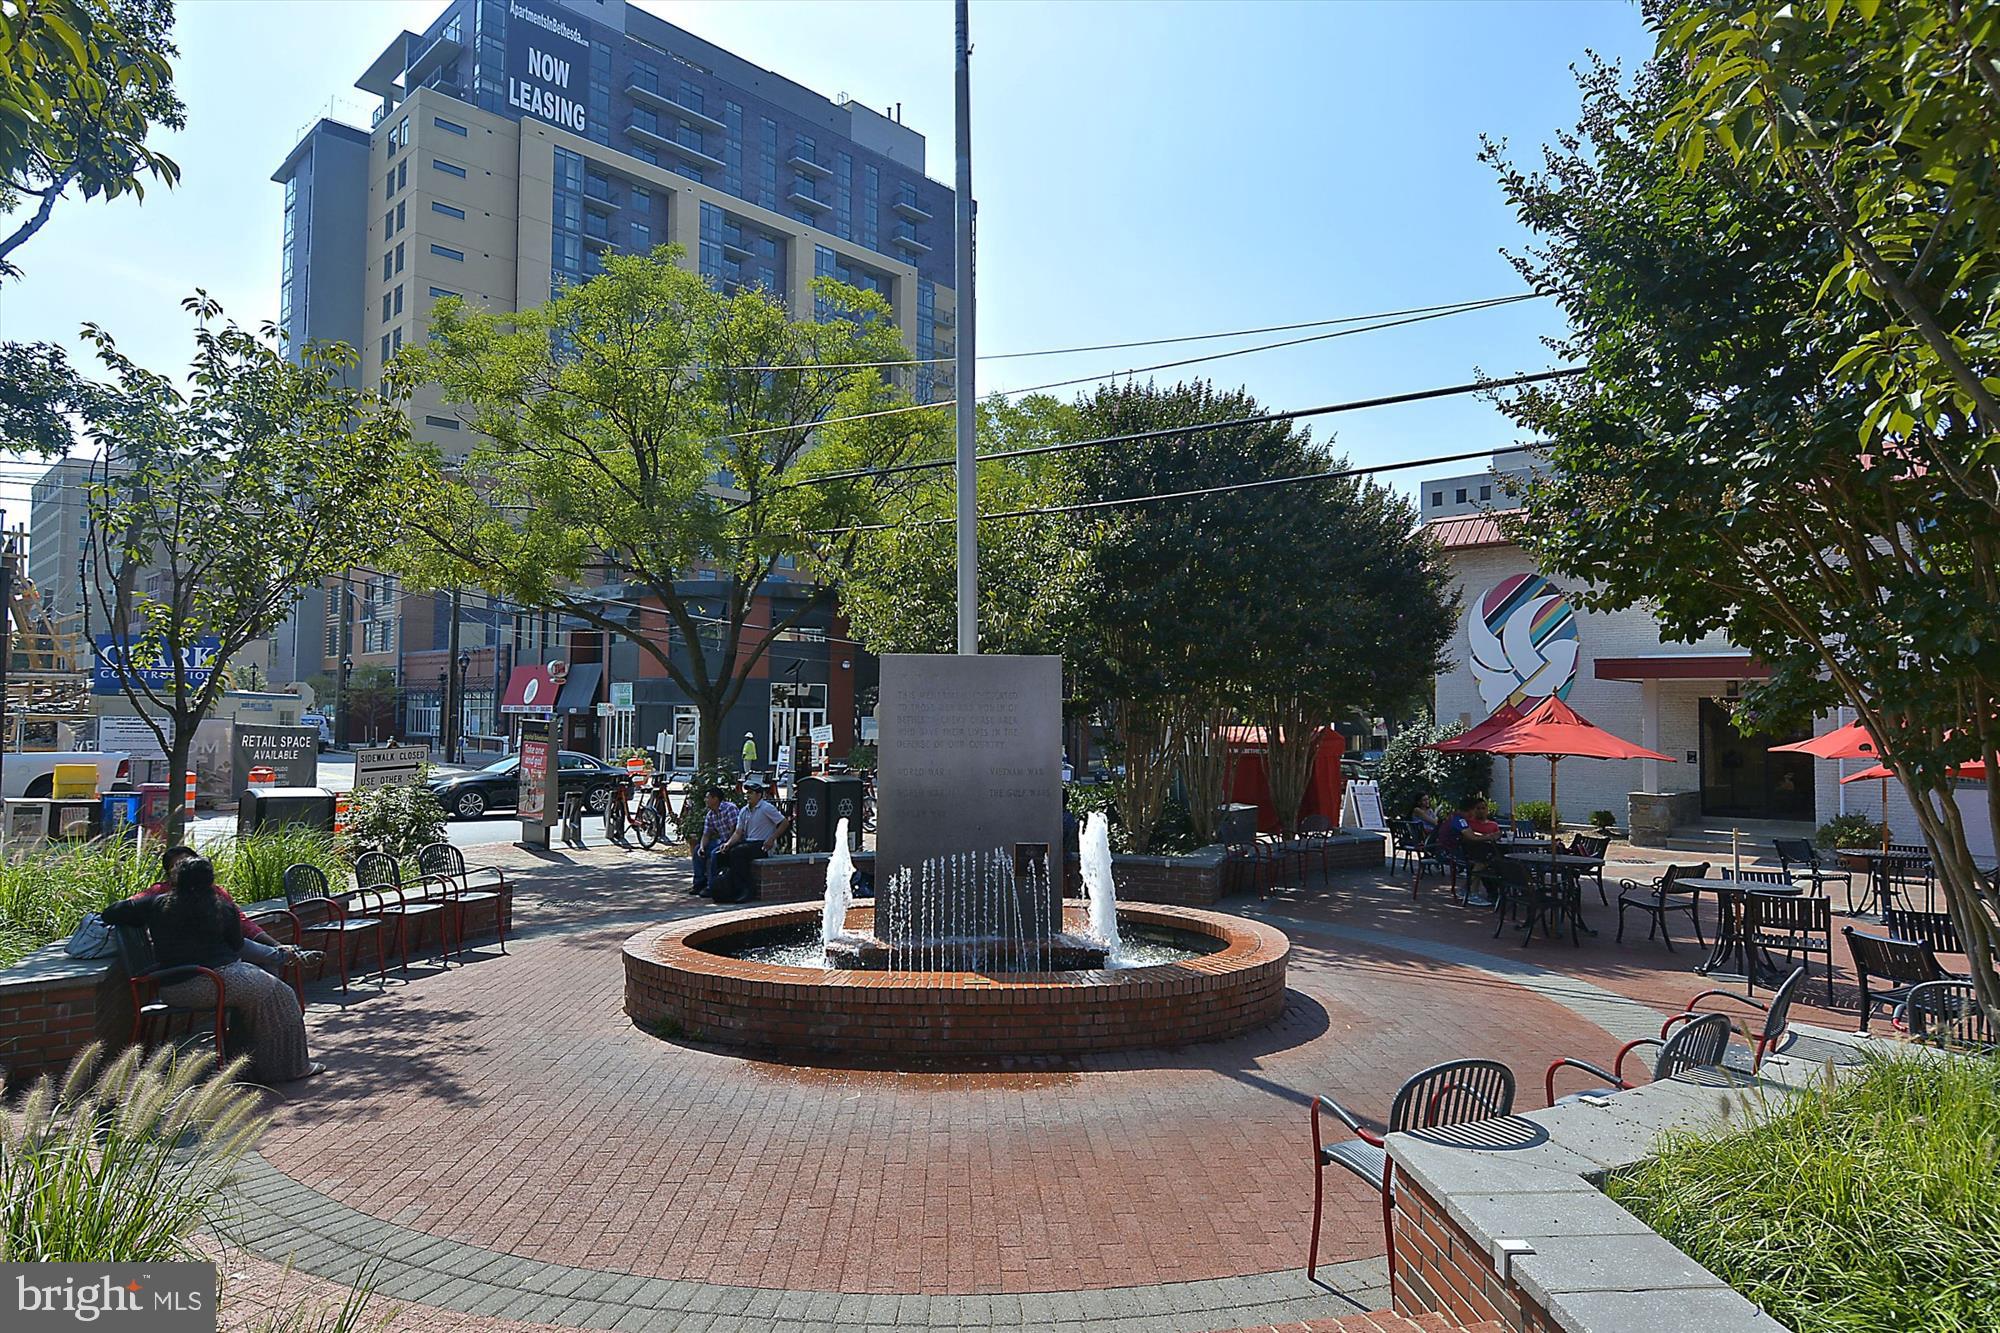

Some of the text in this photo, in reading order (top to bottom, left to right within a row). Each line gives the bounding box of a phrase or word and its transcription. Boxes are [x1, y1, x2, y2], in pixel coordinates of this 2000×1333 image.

[528, 47, 570, 88] NOW
[509, 77, 586, 131] LEASING
[241, 735, 311, 748] RETAIL SPACE
[253, 750, 299, 760] AVAILABLE
[360, 751, 425, 763] SIDEWALK CLOSED
[360, 777, 376, 787] USE
[380, 775, 403, 785] OTHER
